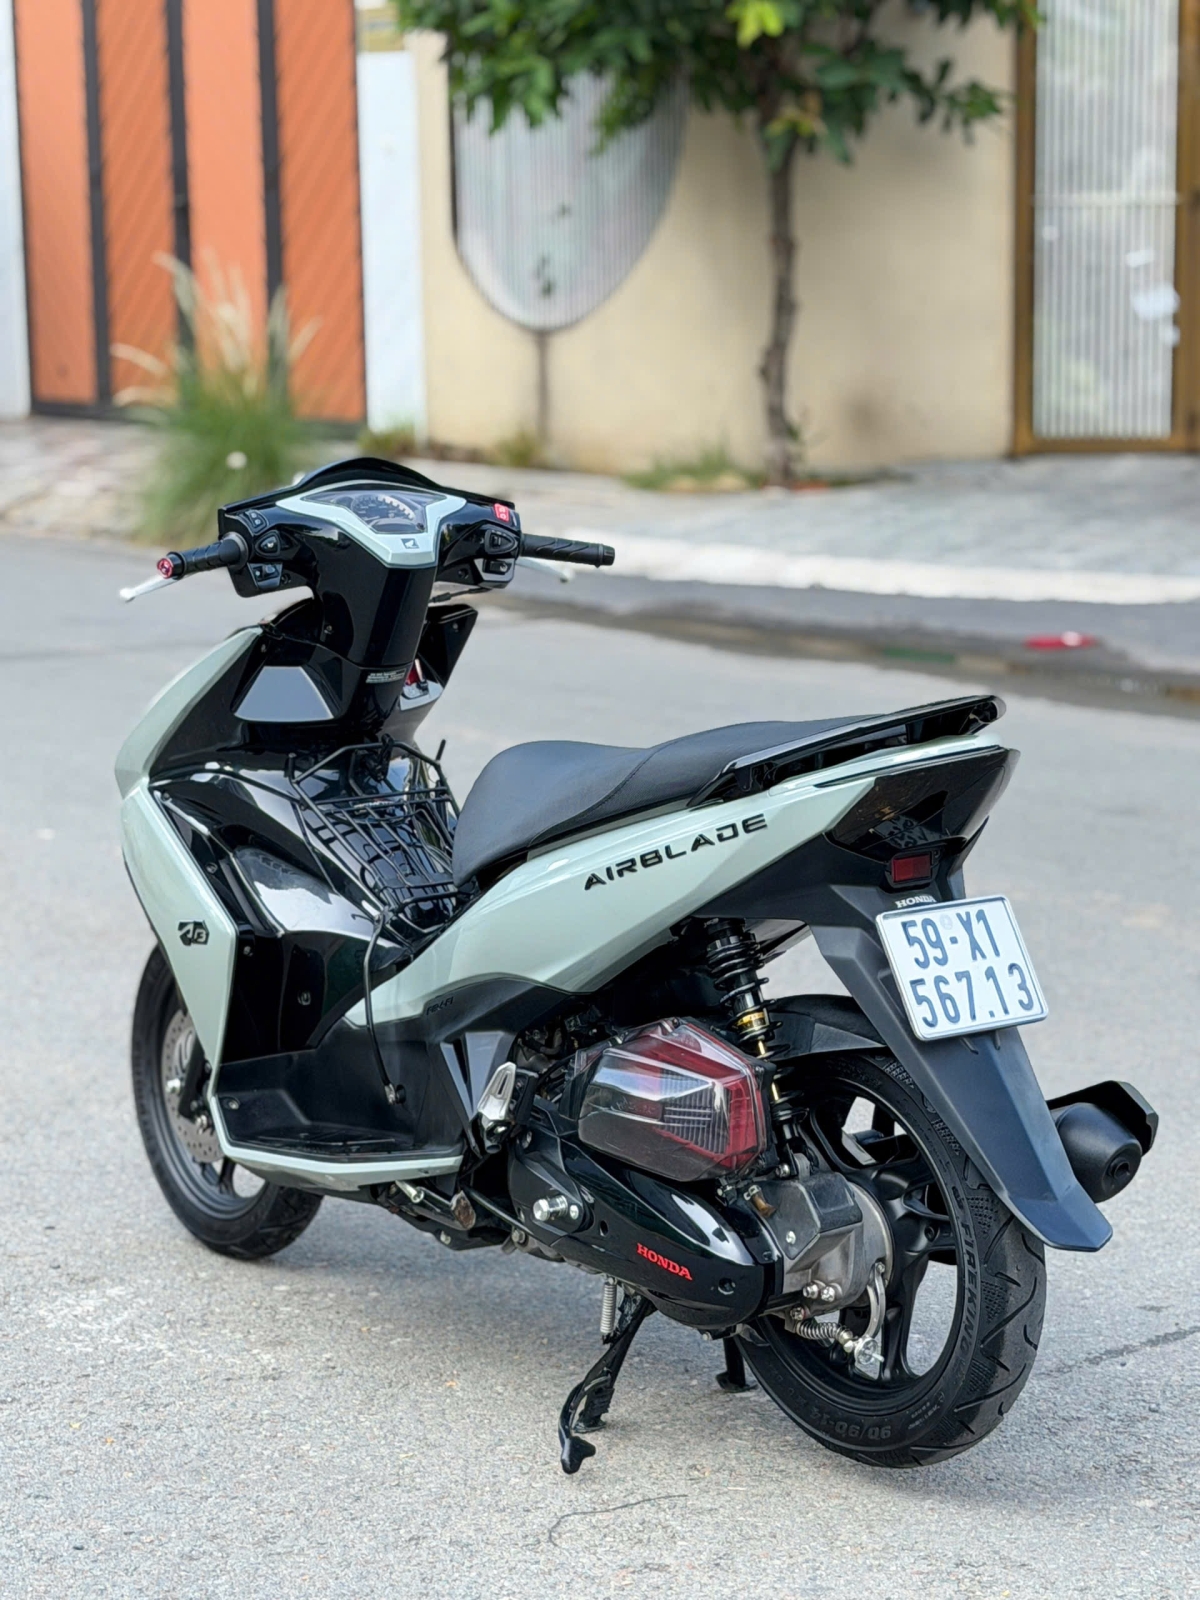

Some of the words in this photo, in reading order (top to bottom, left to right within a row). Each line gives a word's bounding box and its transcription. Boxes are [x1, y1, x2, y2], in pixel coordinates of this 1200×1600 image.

[584, 813, 768, 890] AIRBLADE
[894, 895, 937, 909] HONDA
[901, 908, 1001, 969] 59-X1
[909, 962, 1034, 1028] 567.13
[636, 1242, 693, 1281] HONDA
[959, 1221, 981, 1352] FIREKING
